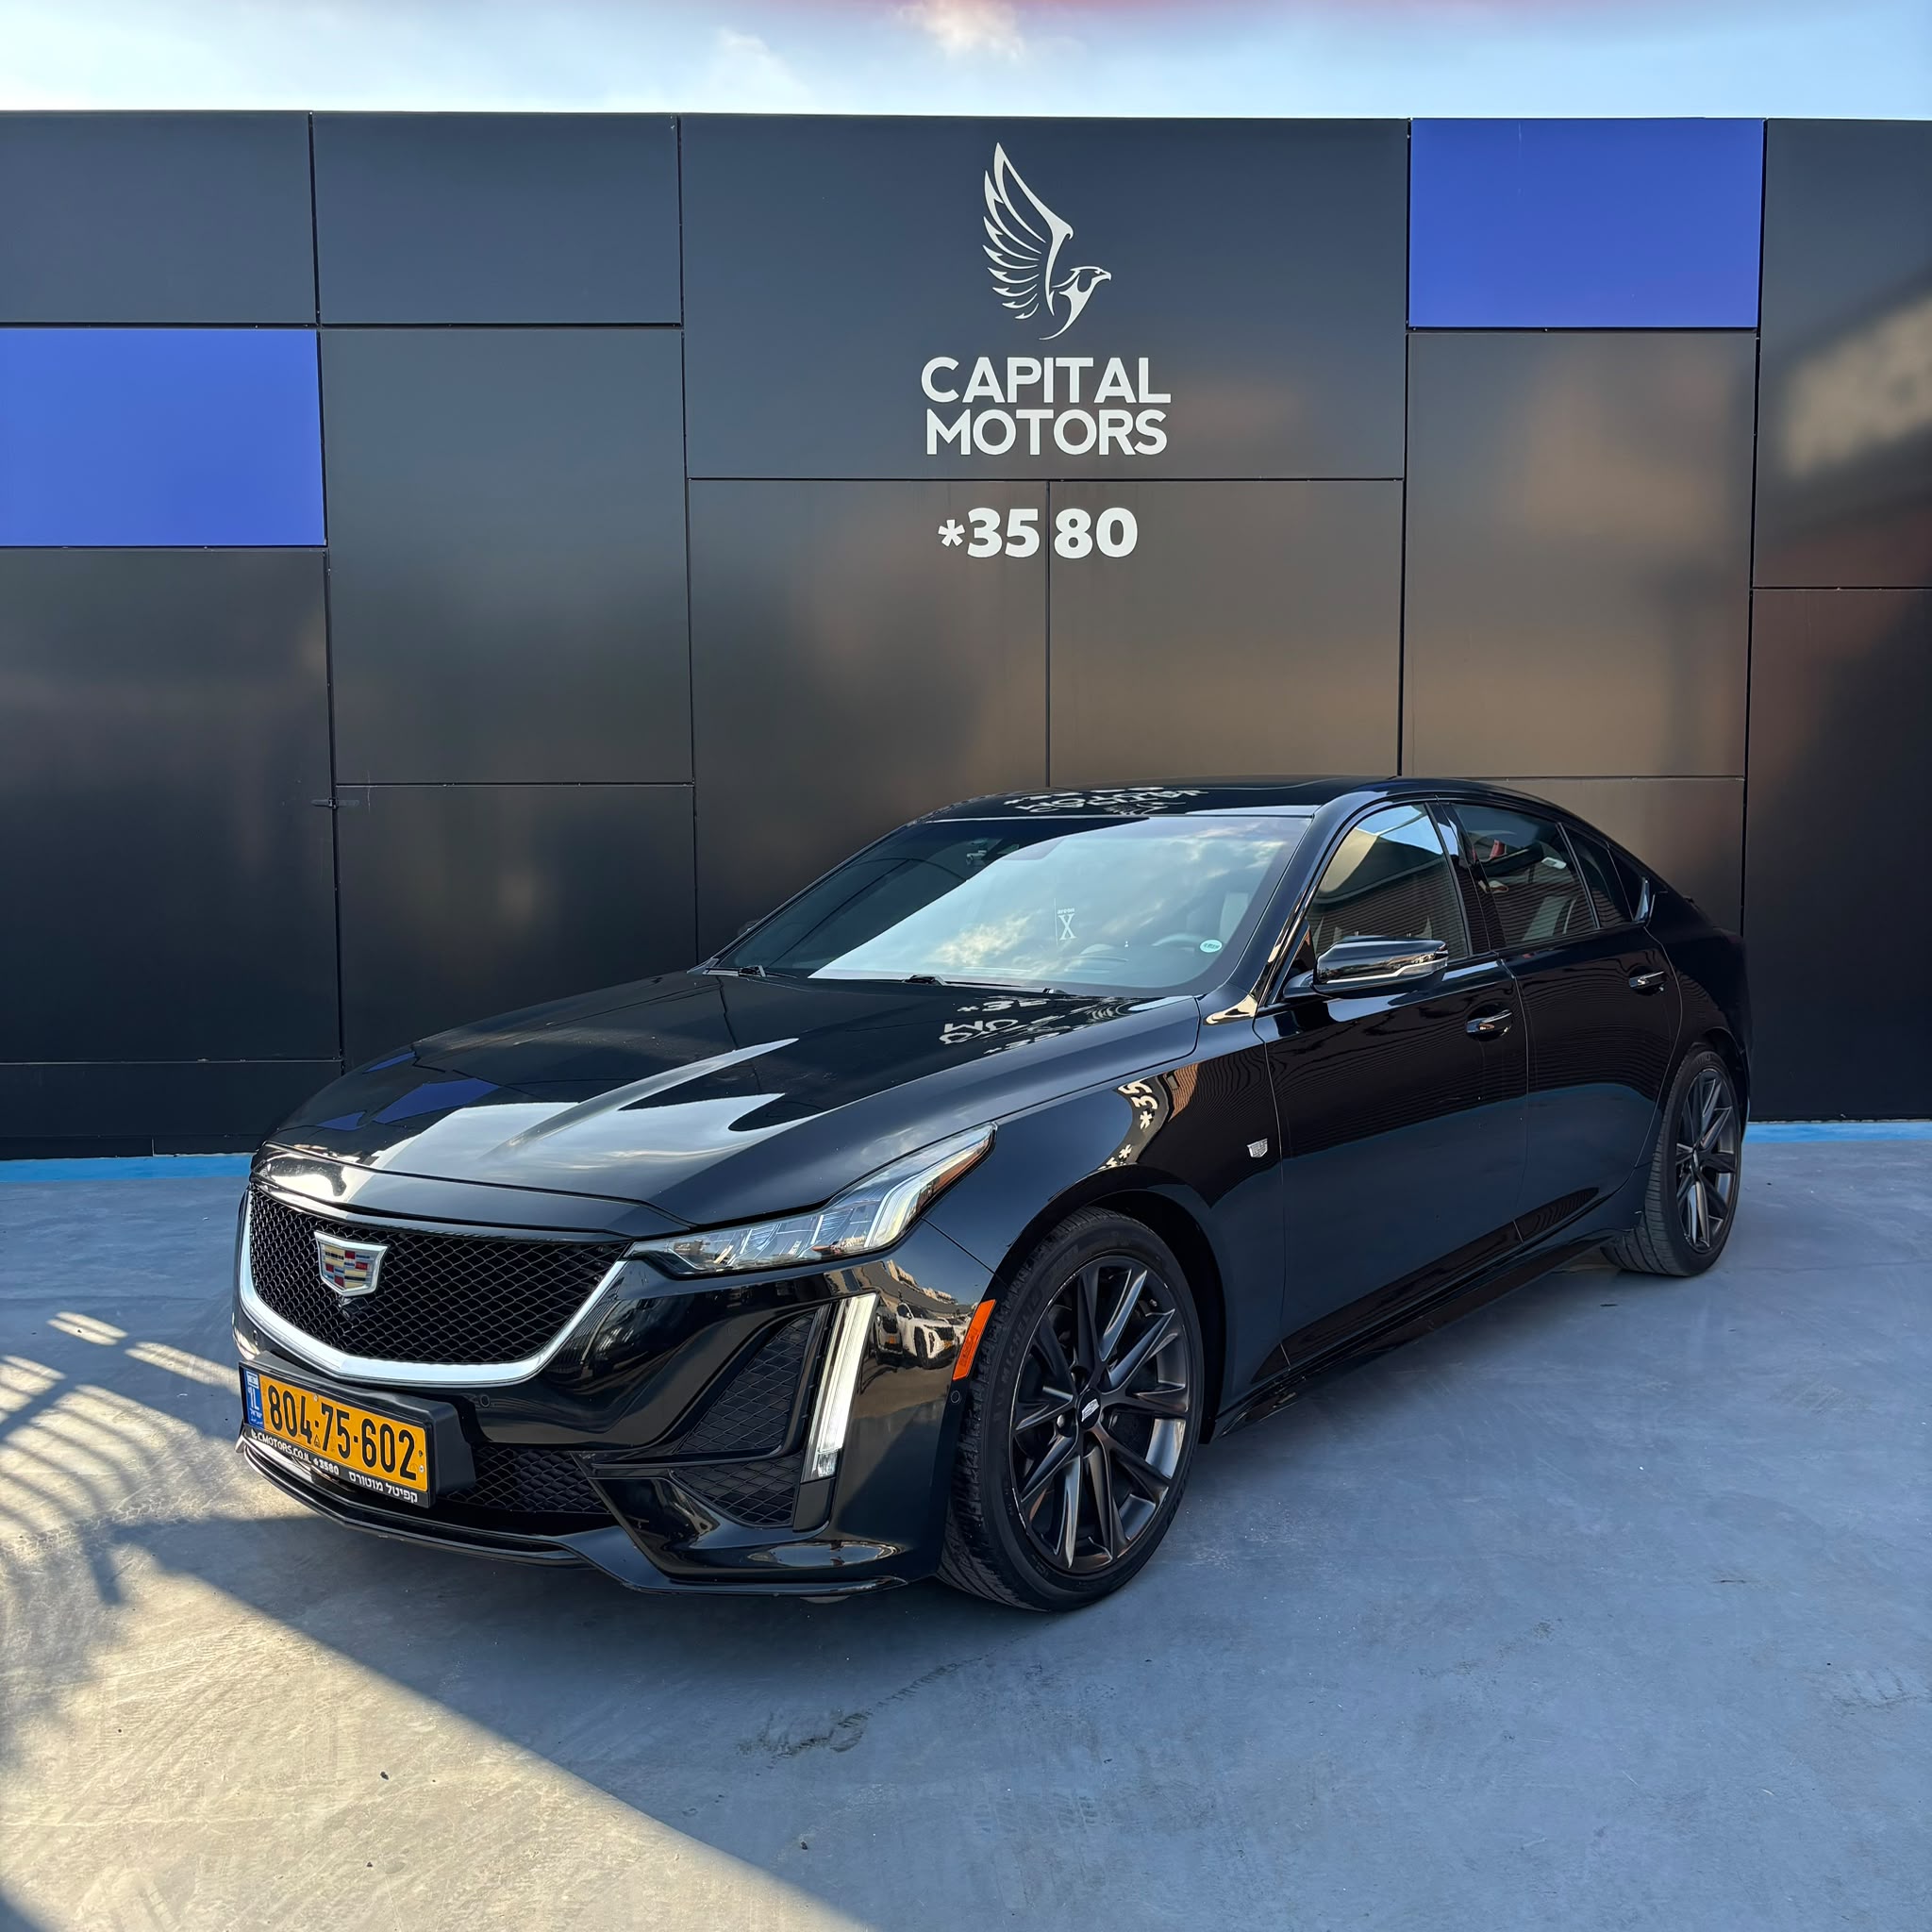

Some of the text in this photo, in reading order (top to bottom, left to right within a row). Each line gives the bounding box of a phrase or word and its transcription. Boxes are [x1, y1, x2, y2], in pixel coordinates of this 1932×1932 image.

[921, 356, 1172, 404] CAPITAL
[926, 408, 1168, 456] MOTORS
[348, 1471, 418, 1504] קפיטל מוטורס
